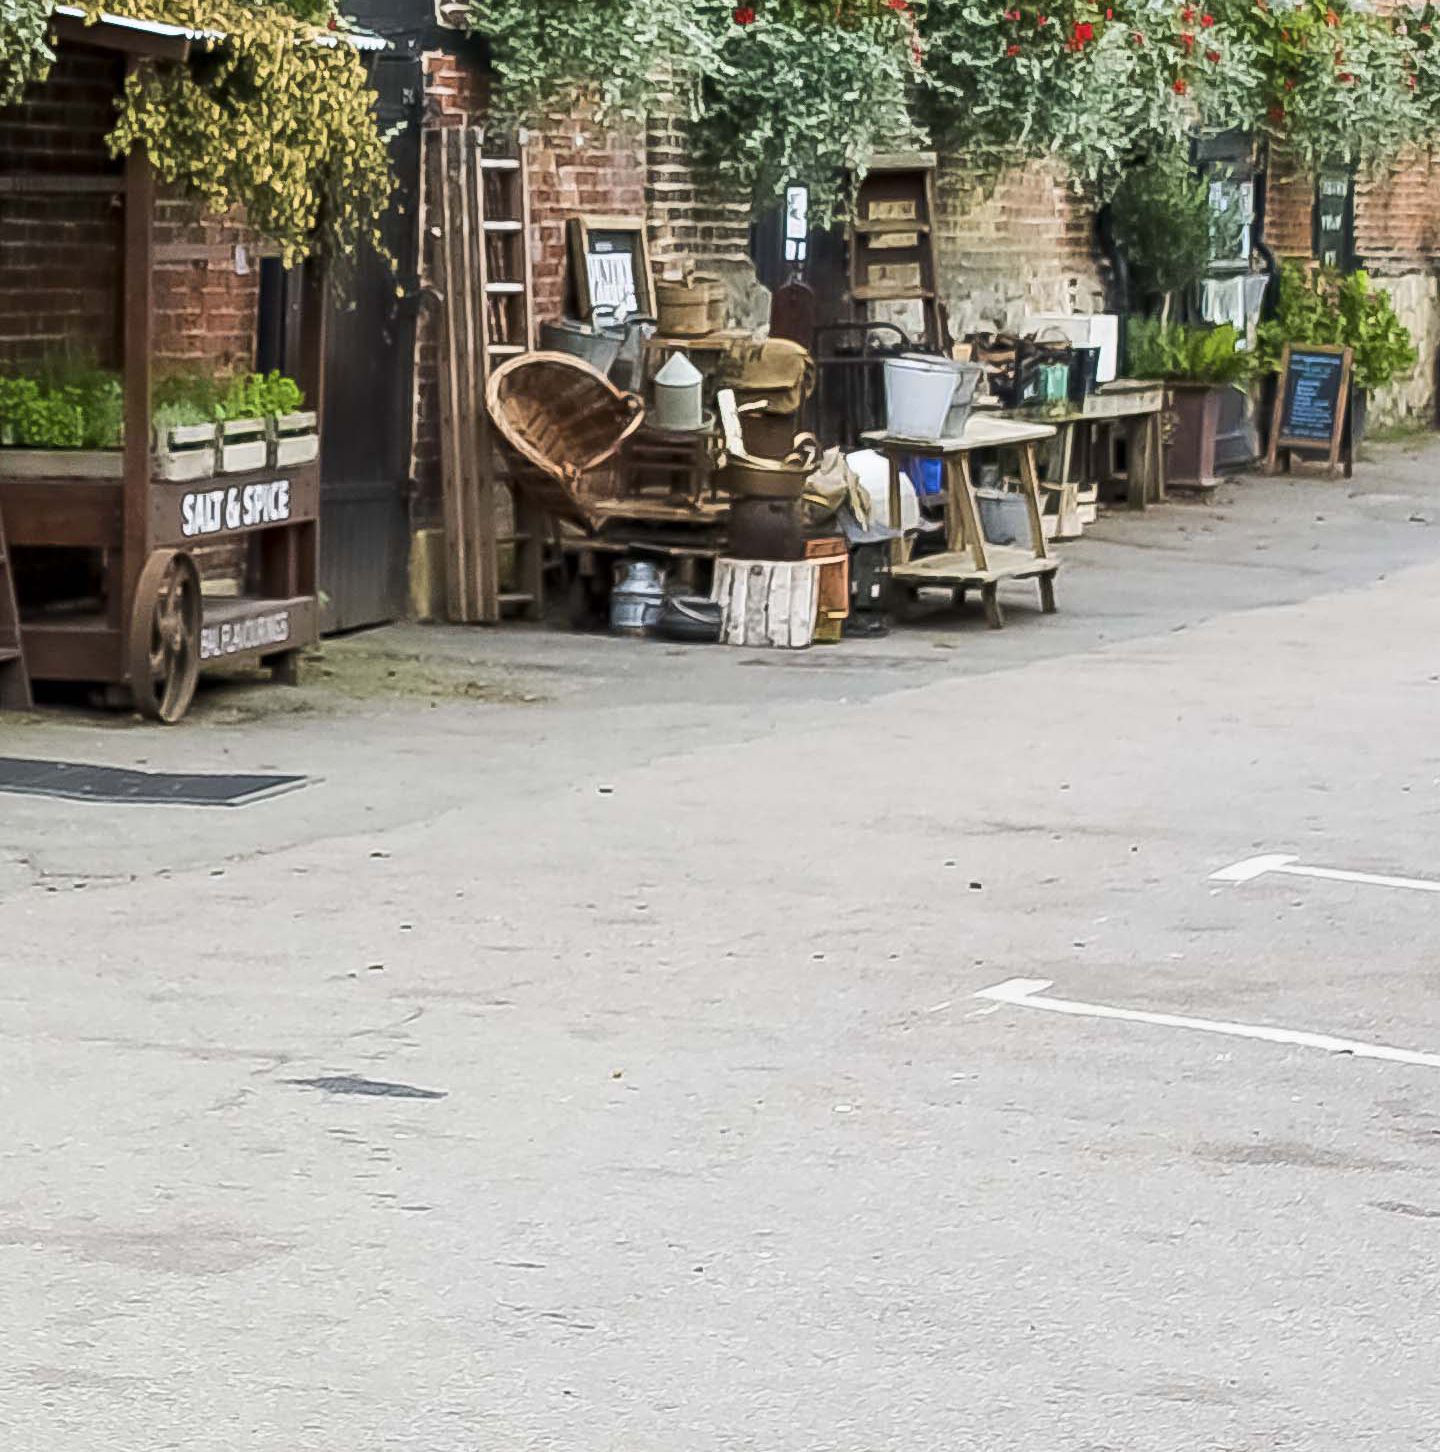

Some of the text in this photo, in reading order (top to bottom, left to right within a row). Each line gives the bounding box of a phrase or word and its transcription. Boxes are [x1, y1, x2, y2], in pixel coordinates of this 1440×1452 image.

[182, 480, 290, 536] SALT & SPICE
